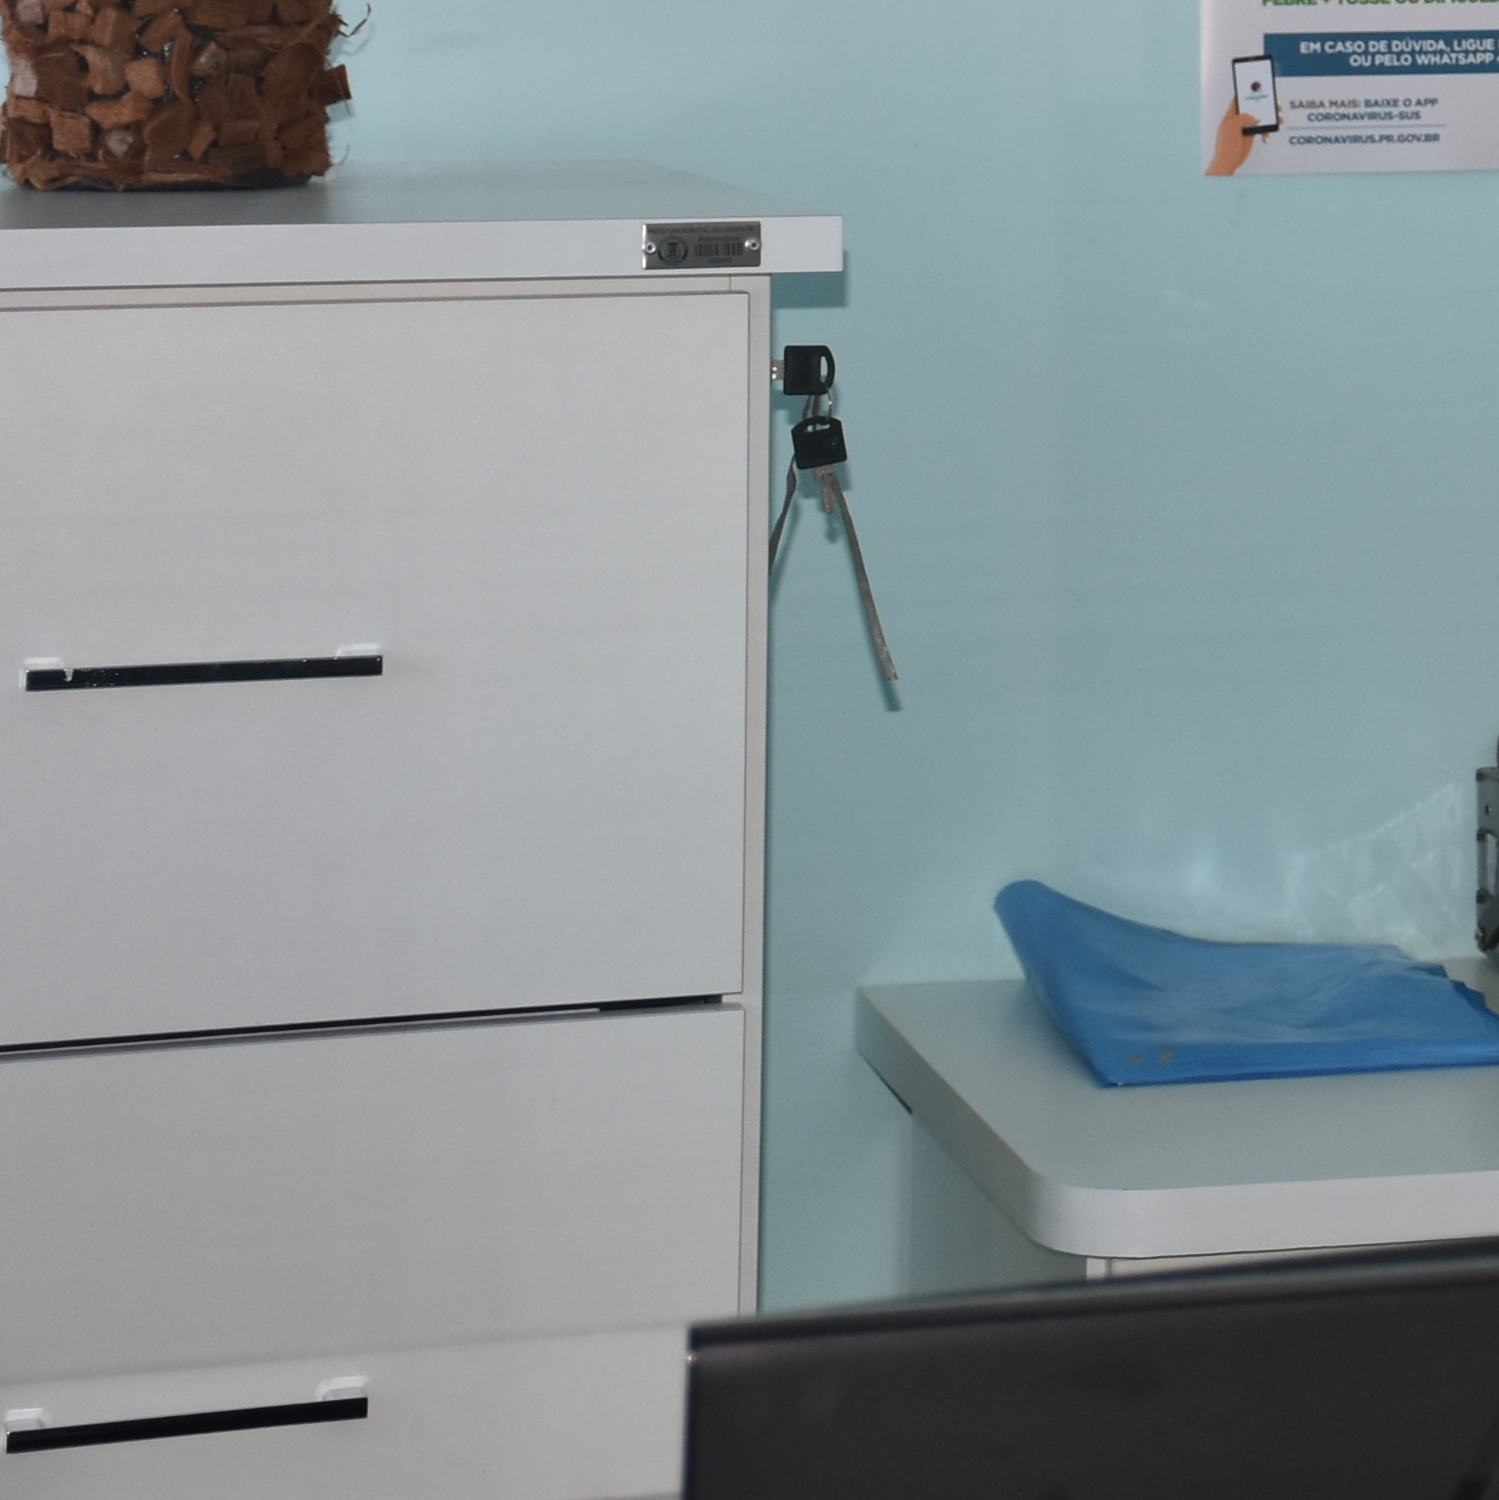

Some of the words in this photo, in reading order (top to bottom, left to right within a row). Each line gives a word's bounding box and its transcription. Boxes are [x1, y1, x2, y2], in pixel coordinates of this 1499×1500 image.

[1300, 41, 1321, 54] EM
[1324, 40, 1366, 54] CASO
[1368, 40, 1389, 52] DE
[1391, 37, 1450, 53] DÚVIDA,
[1453, 38, 1495, 51] LIGUE
[1349, 55, 1372, 67] OU
[1374, 54, 1412, 67] PELO
[1415, 52, 1494, 66] WHATSAPP
[1289, 100, 1326, 110] SAIBA
[1363, 99, 1400, 109] BAIXE
[1402, 99, 1412, 107] O
[1415, 97, 1439, 107] APP
[1307, 110, 1422, 123] CORONAVIRUS-SUS
